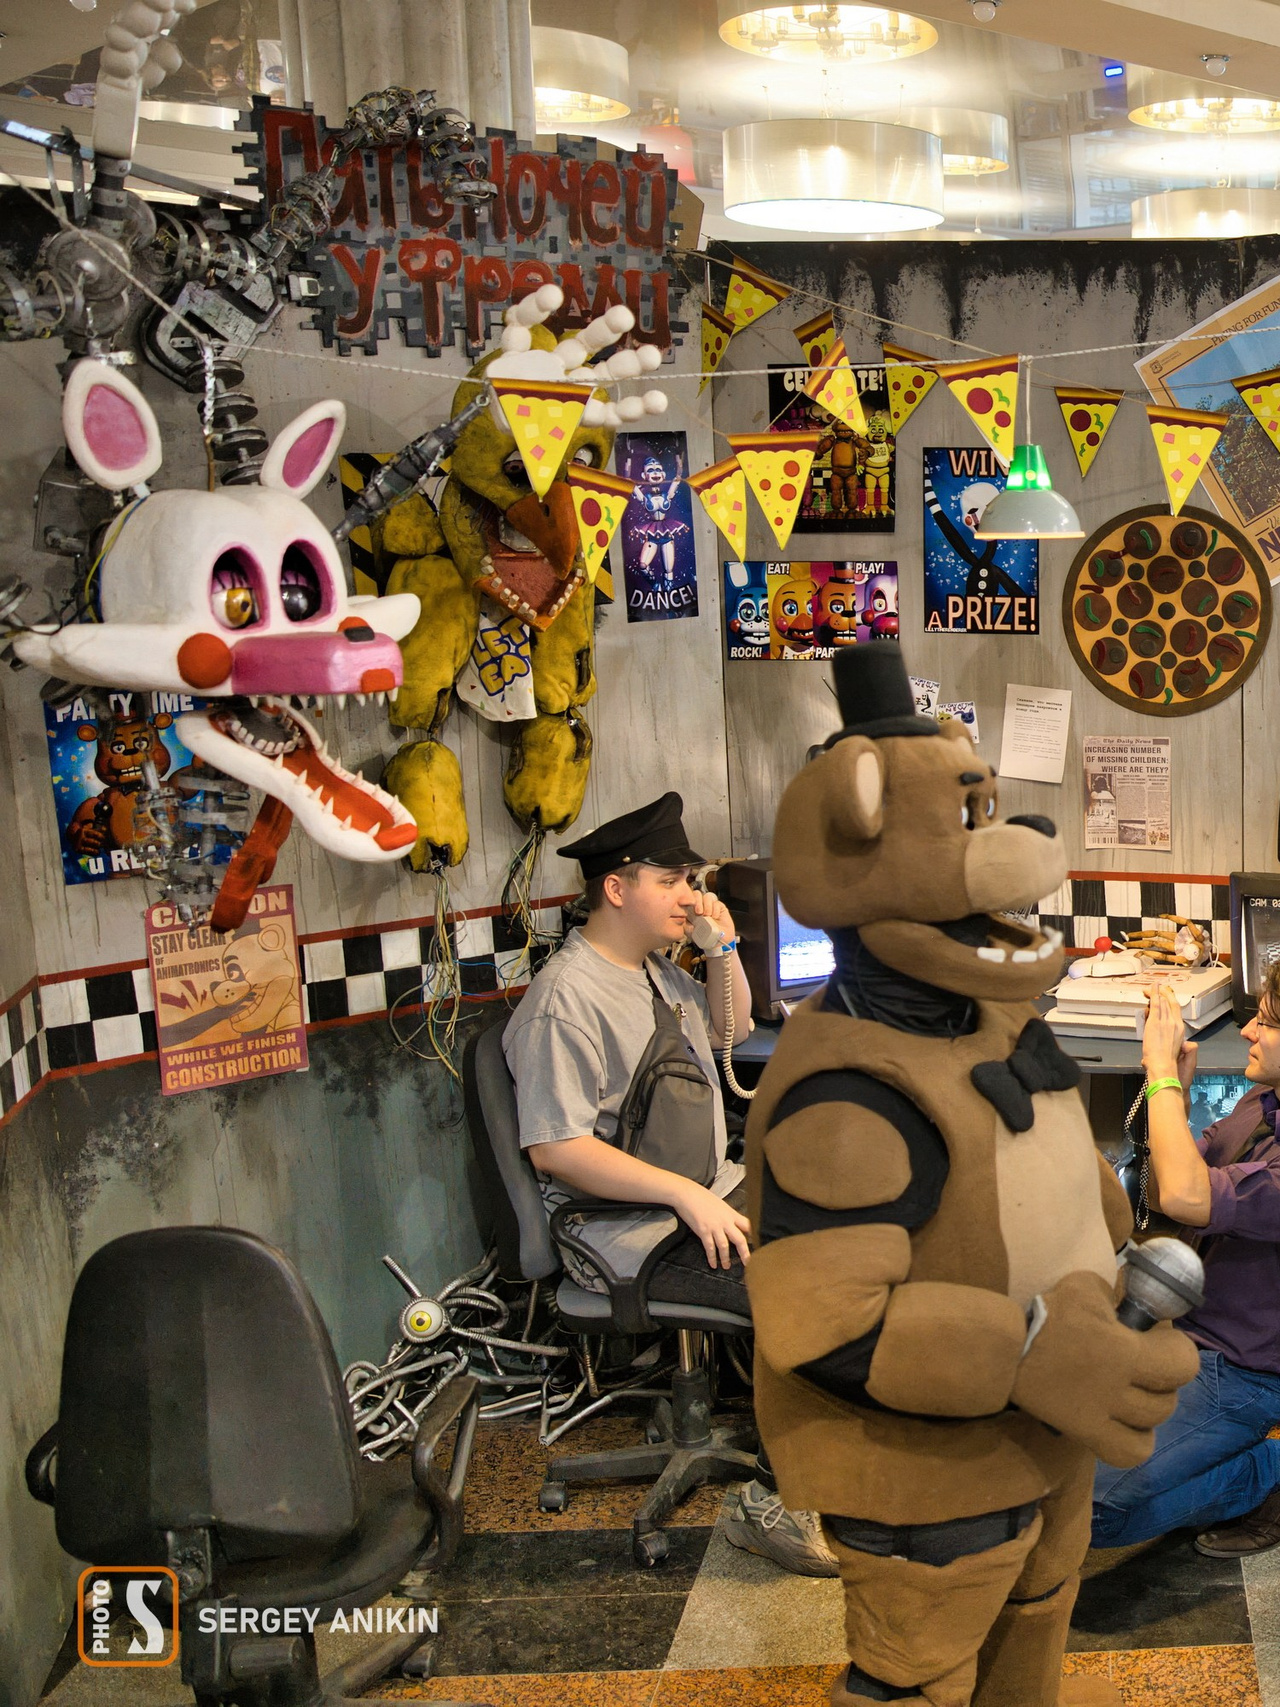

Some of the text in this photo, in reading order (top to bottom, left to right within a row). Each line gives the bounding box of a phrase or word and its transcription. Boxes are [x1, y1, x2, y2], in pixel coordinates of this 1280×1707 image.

[1242, 307, 1264, 331] FOR
[767, 563, 790, 574] EAT!
[855, 563, 885, 574] PLAY!
[630, 585, 696, 610] DANCE!
[928, 596, 1036, 631] A PRIZE!
[730, 646, 762, 658] ROCK!
[1084, 746, 1129, 754] INCREASING
[1086, 755, 1169, 764] OF MISSING CHILDREN:
[1101, 765, 1127, 773] WHERE
[1146, 766, 1169, 774] THEY?
[88, 856, 105, 875] u
[1249, 898, 1267, 907] CAM
[152, 932, 184, 956] STAY
[155, 957, 165, 966] OF
[156, 958, 221, 981] ANIMATRONICS
[167, 1032, 297, 1066] WHILE WE FINISH
[165, 1047, 301, 1090] CONSTRUCTION
